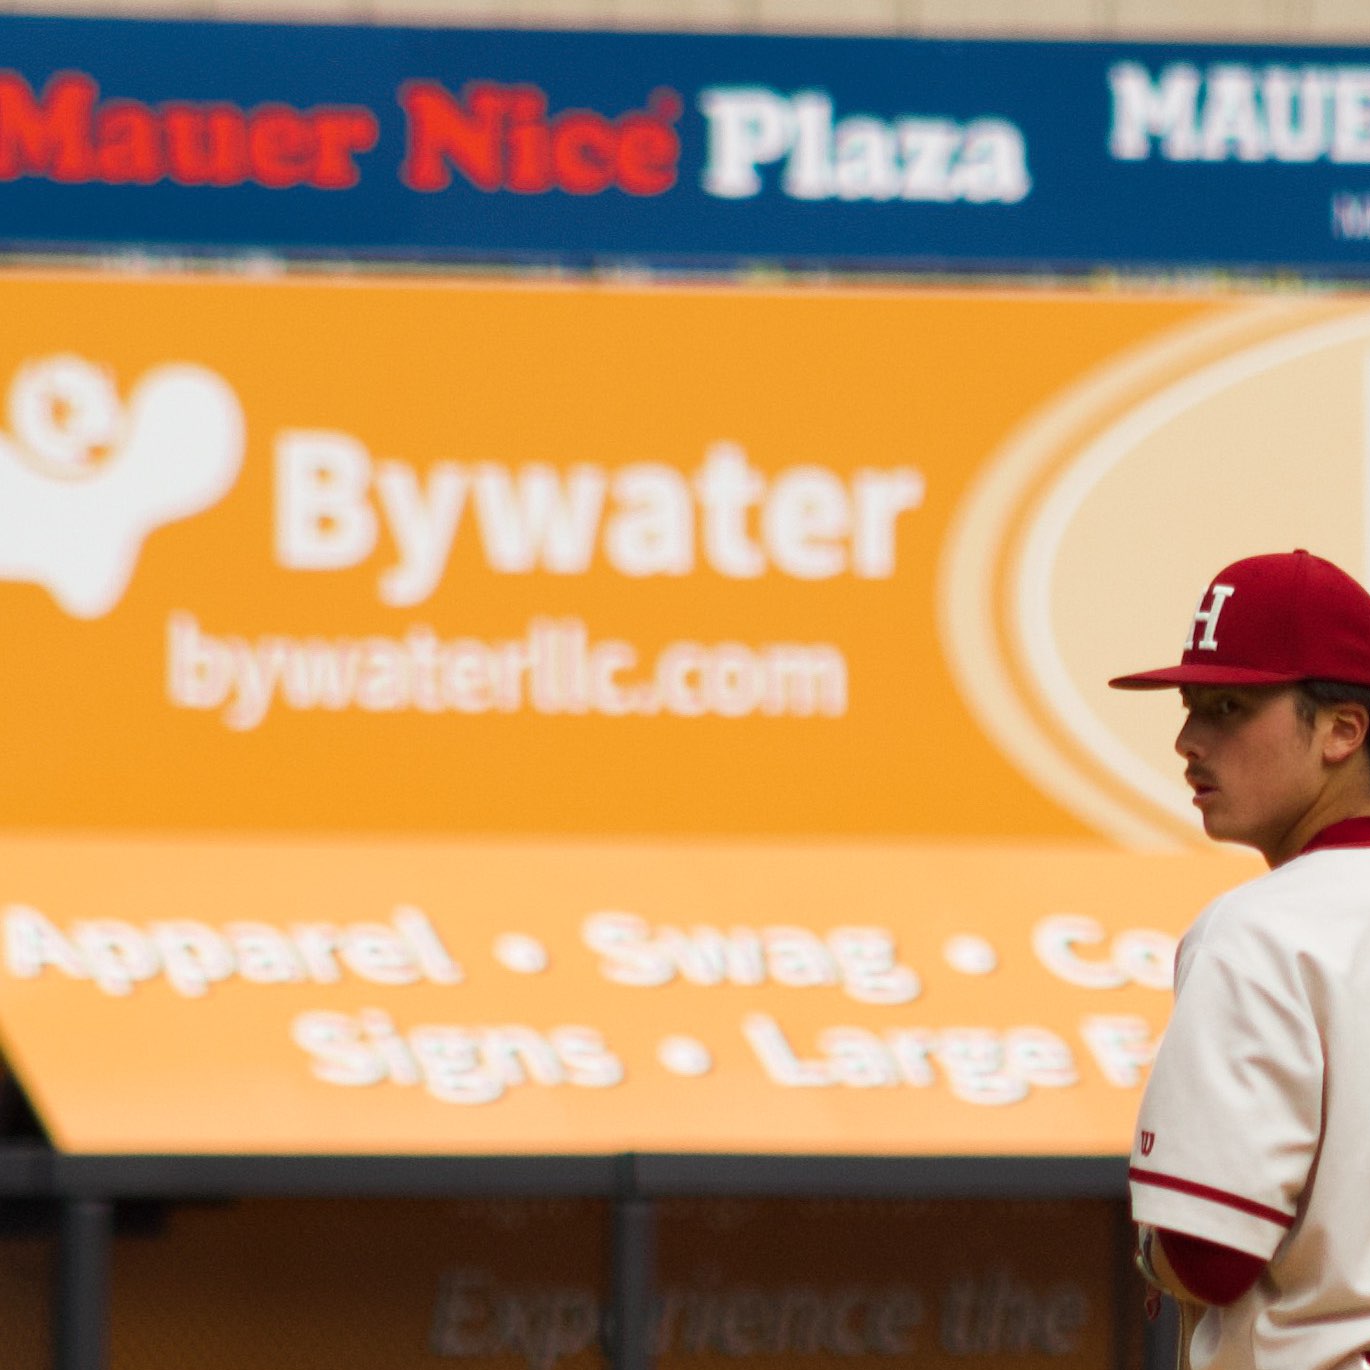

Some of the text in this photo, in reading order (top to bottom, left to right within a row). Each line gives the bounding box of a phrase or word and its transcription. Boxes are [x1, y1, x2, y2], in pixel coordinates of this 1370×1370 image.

[0, 69, 379, 190] Mauer
[702, 88, 1030, 203] Plaza
[274, 430, 924, 606] Bywater
[1184, 583, 1235, 650] H
[167, 610, 847, 731] bywaterllc.com
[3, 906, 462, 996] Apparel
[583, 911, 921, 1004] Swag
[294, 1011, 622, 1104] Signs
[745, 1014, 1078, 1105] Large
[937, 1270, 1085, 1356] the
